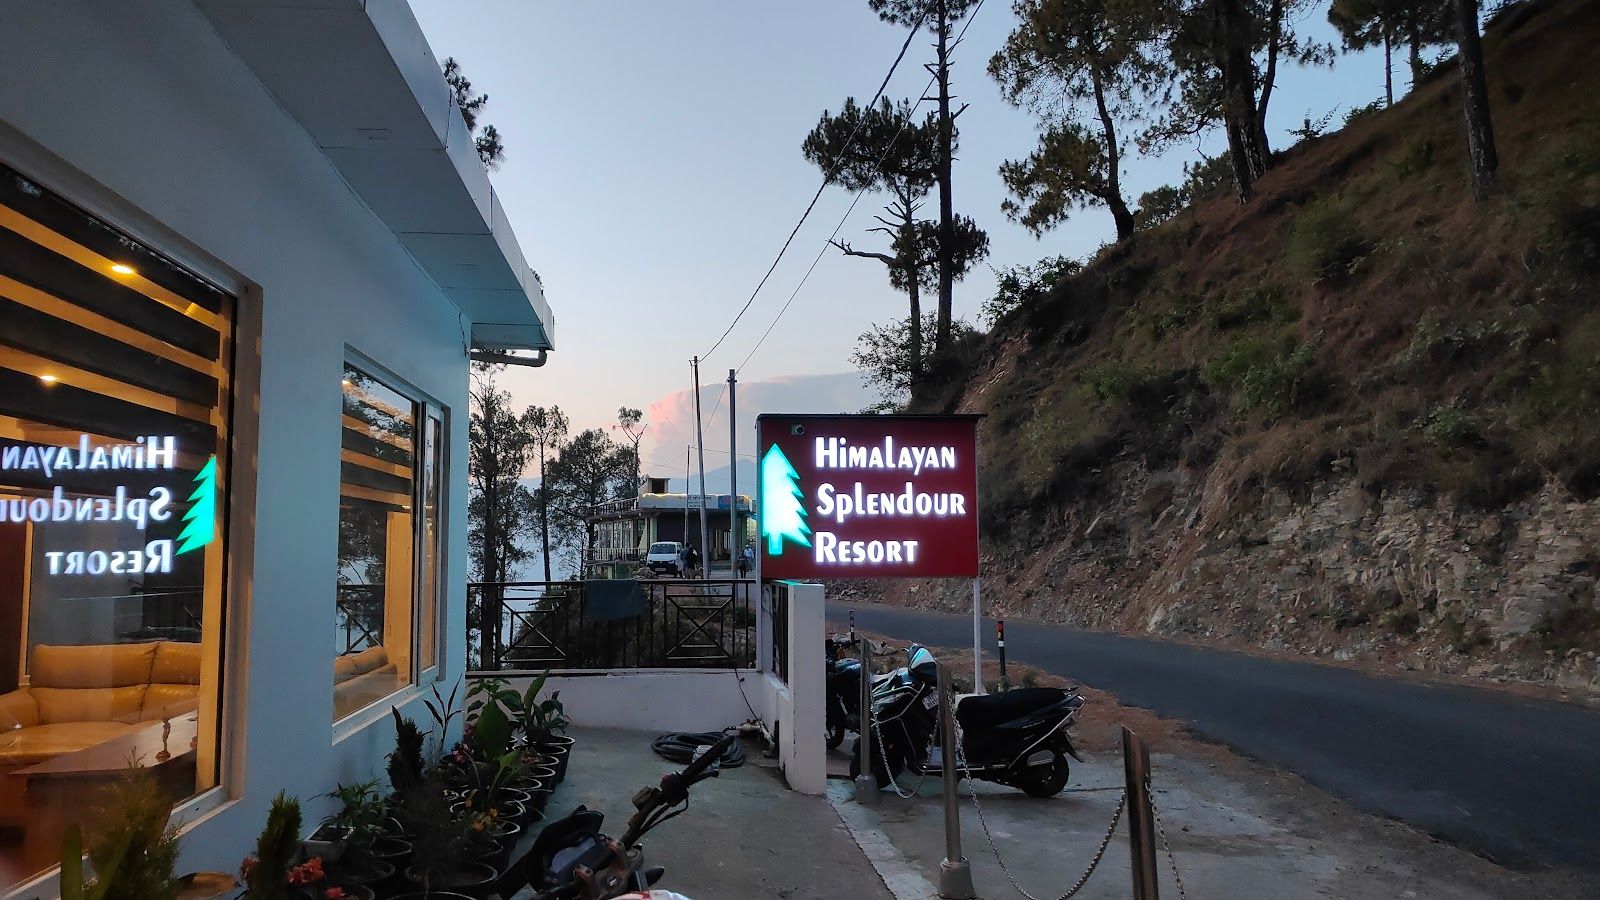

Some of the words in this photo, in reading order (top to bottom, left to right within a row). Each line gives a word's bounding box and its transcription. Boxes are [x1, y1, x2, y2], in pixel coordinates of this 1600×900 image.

[815, 435, 956, 476] Himalayan
[816, 481, 967, 523] Splendour
[815, 531, 919, 563] Resort
